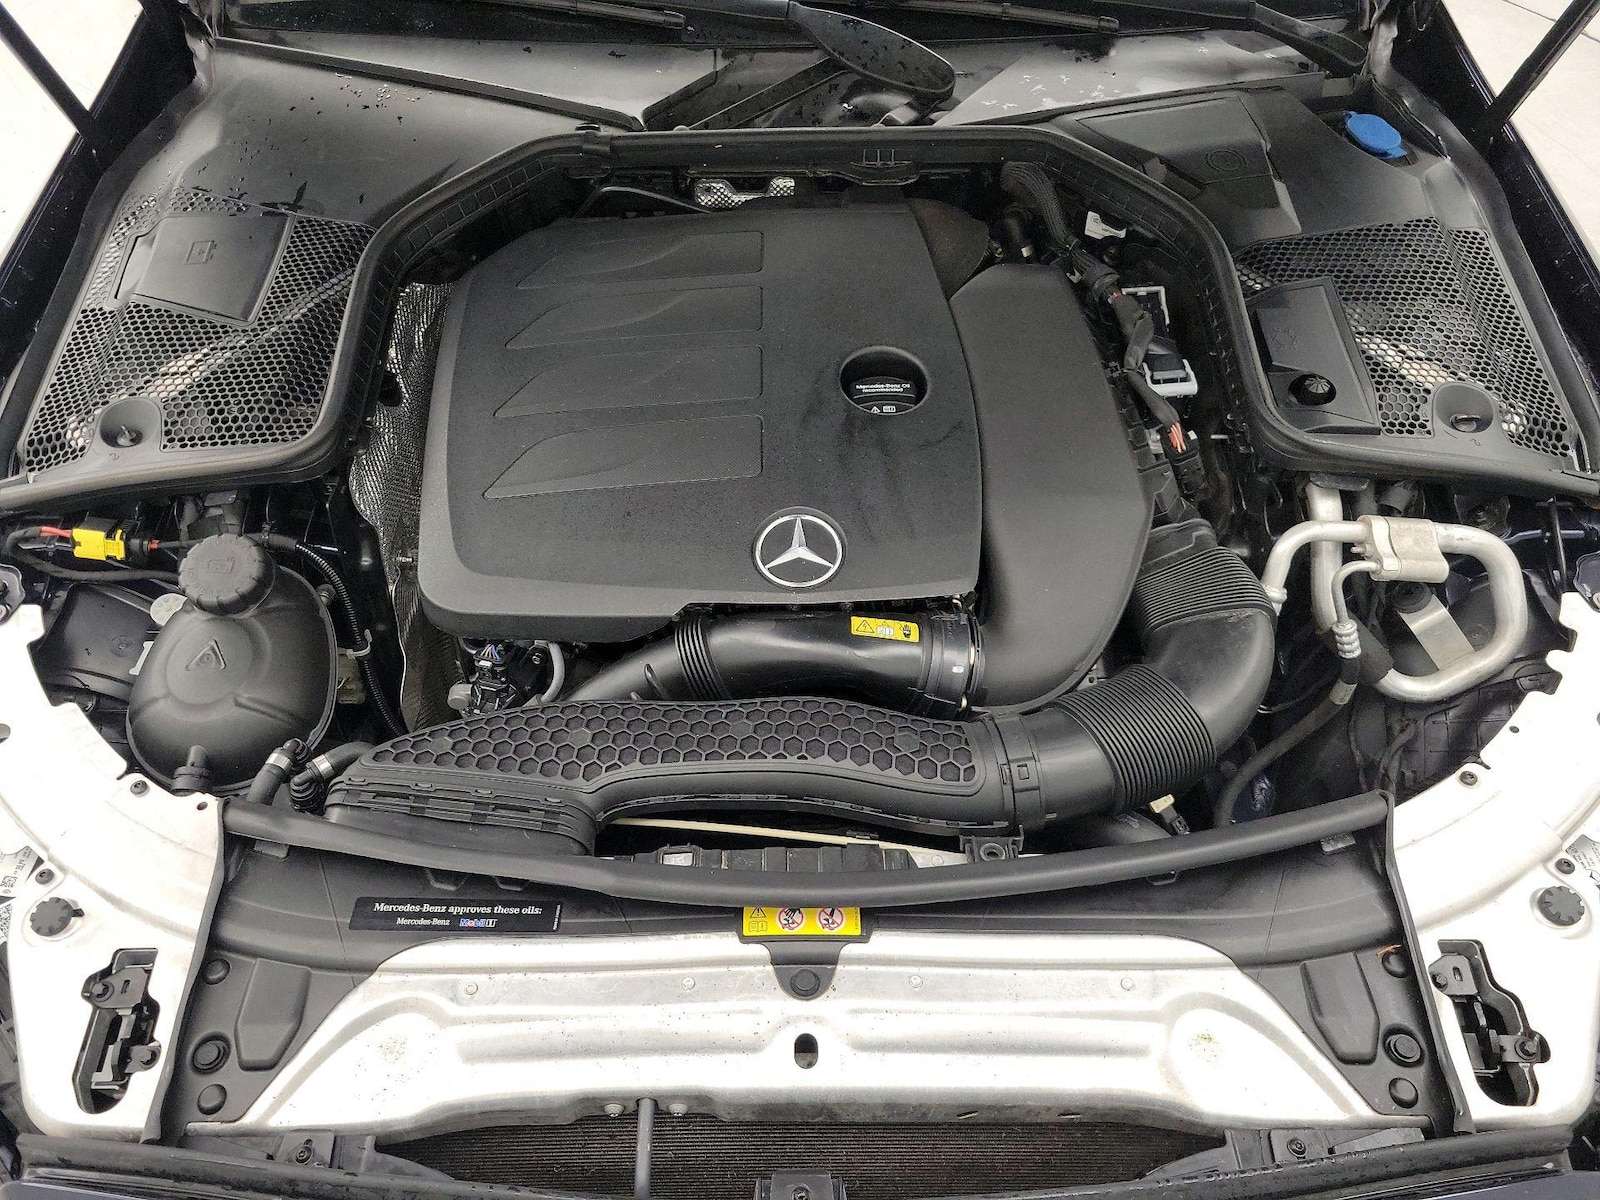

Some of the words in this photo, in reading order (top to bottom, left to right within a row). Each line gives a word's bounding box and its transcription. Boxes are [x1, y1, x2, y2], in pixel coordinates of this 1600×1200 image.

[373, 902, 447, 913] Mercedes-Benz
[447, 905, 492, 915] approves
[493, 905, 520, 914] these
[521, 906, 543, 914] oils:
[396, 917, 451, 926] Mercedes-Benz
